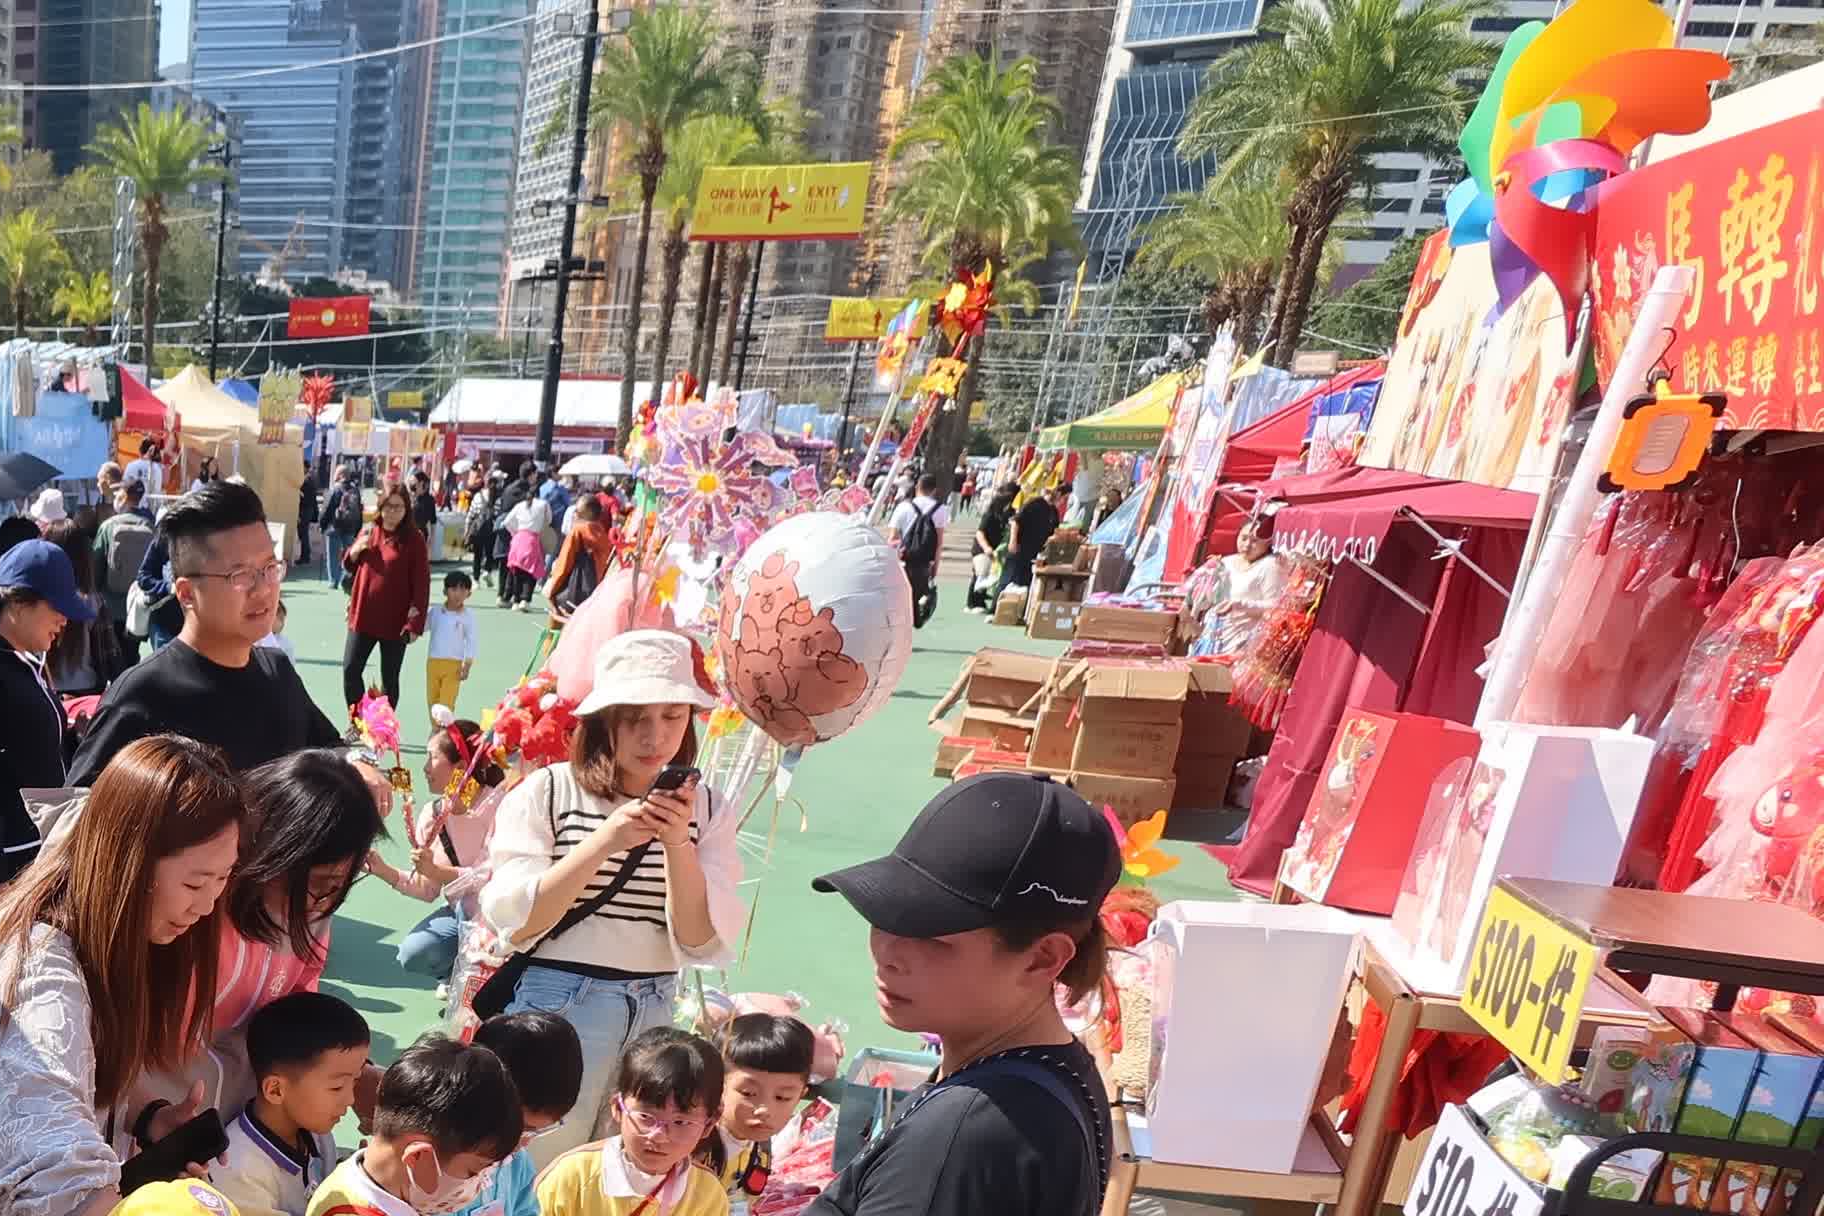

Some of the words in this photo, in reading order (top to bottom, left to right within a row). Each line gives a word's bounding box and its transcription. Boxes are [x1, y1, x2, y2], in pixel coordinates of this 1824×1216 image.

[710, 189, 735, 199] ONE
[737, 188, 767, 200] WAY
[808, 186, 838, 197] EXIT
[1683, 334, 1780, 396] 時來運轉
